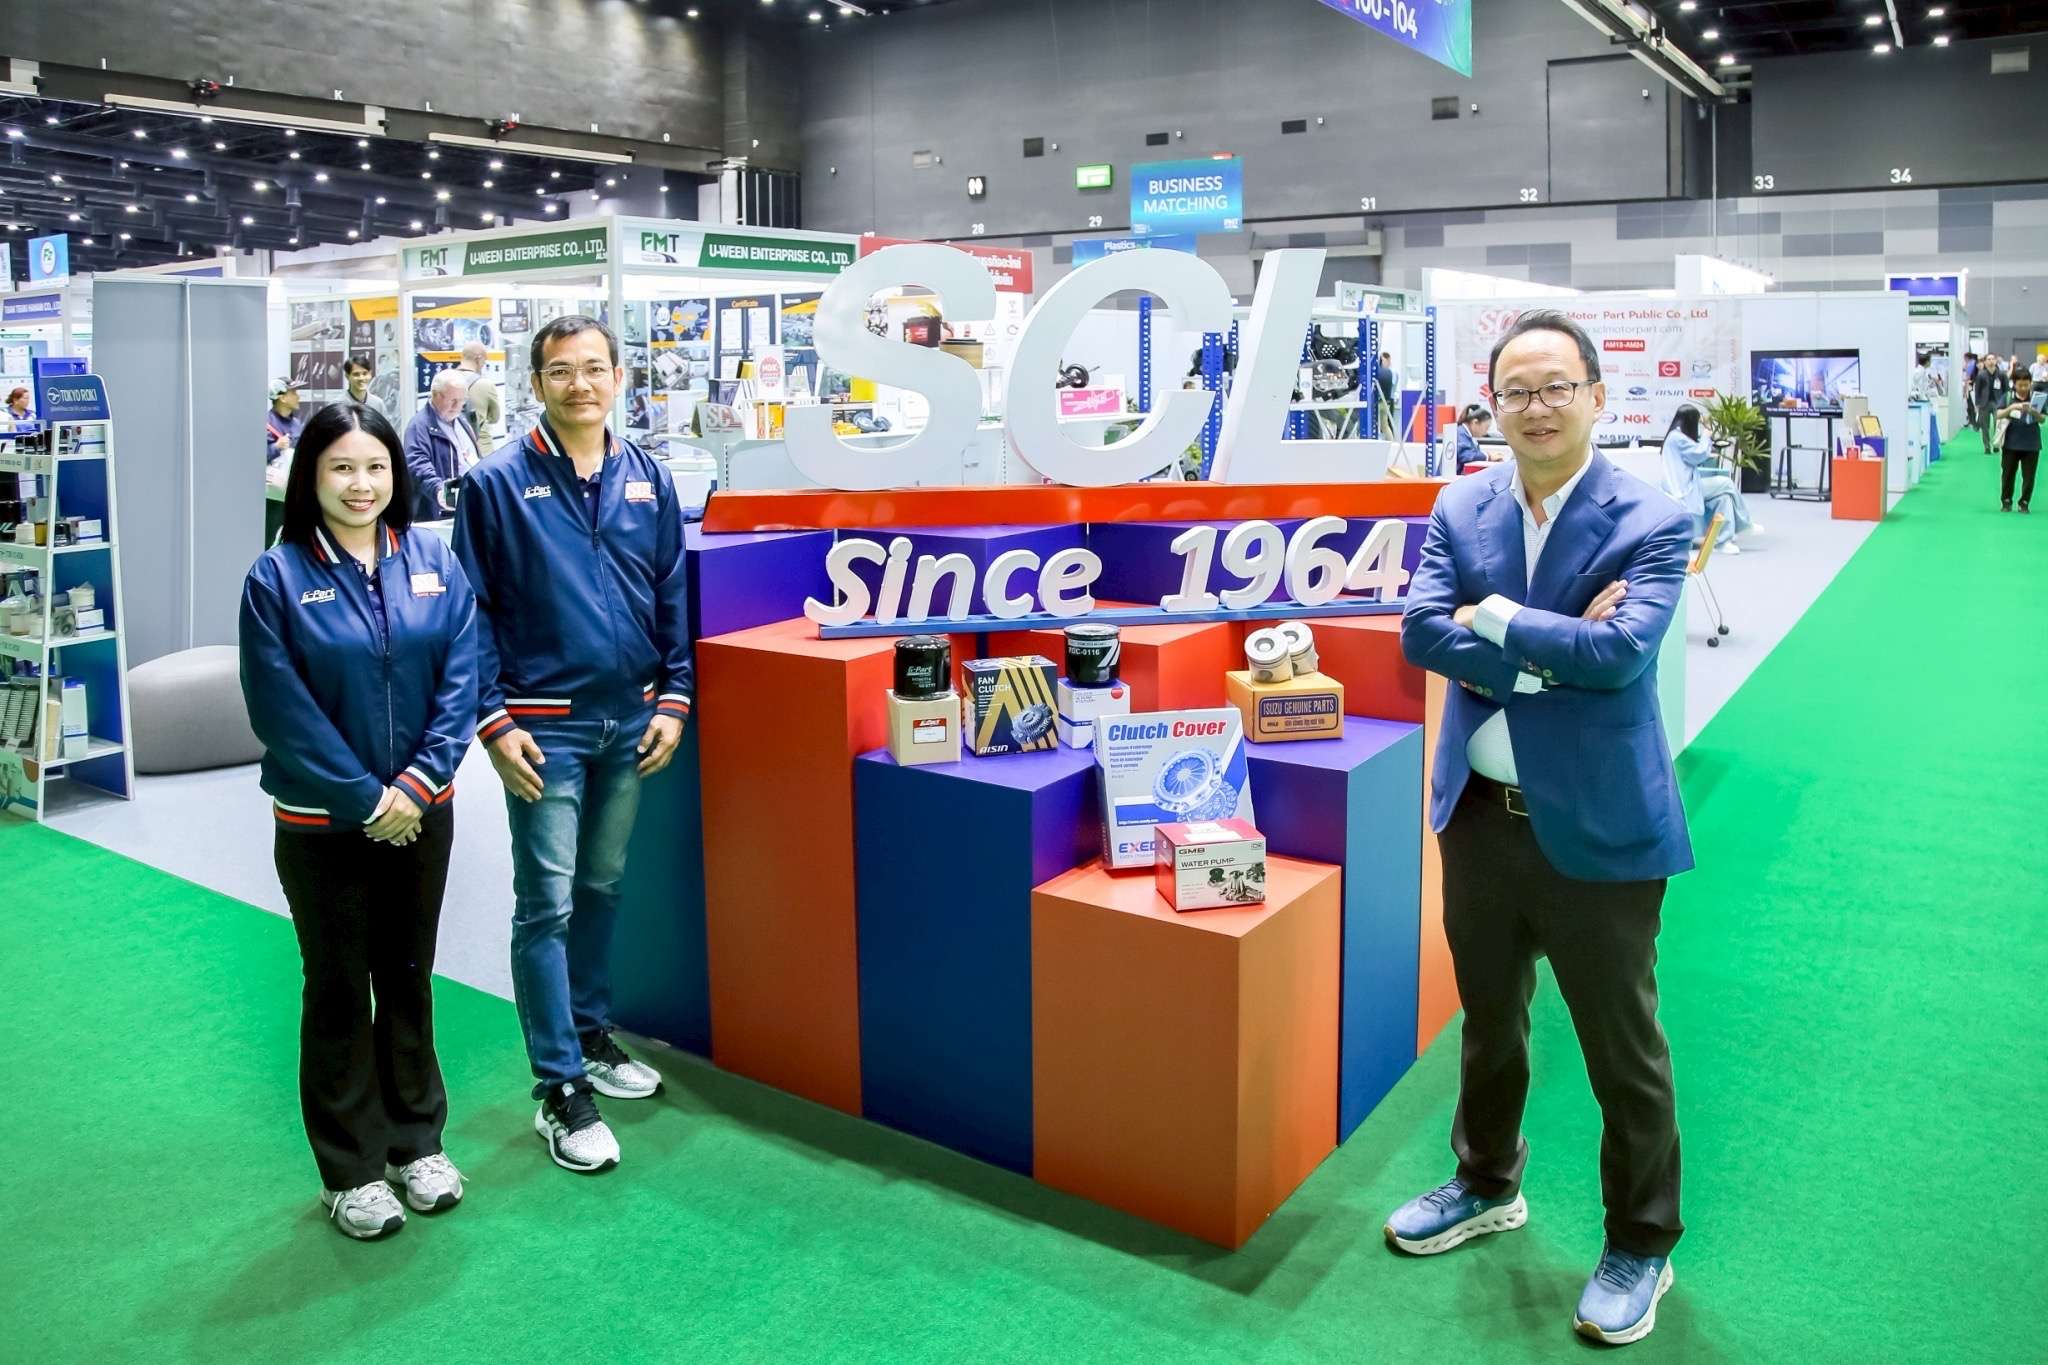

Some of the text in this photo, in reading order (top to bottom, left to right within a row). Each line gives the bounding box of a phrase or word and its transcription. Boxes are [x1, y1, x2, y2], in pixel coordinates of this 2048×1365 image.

[226, 75, 234, 87] J
[334, 89, 344, 101] K
[425, 101, 433, 113] L
[1754, 175, 1774, 189] 33
[1890, 168, 1912, 183] 34
[1149, 175, 1223, 194] BUSINESS
[1520, 188, 1538, 202] 32
[1143, 195, 1228, 213] MATCHING
[1361, 197, 1376, 210] 31
[1089, 216, 1103, 228] 29
[971, 224, 985, 235] 28
[641, 232, 680, 252] FMT
[1104, 241, 1136, 250] Plastics
[421, 247, 449, 267] FMT
[470, 250, 503, 265] U-WEEN
[504, 243, 562, 262] ENTERPRISE
[709, 244, 748, 259] U-WEEN
[750, 246, 809, 263] ENTERPRISE
[1603, 311, 1626, 320] Part
[1629, 309, 1662, 320] Public
[783, 243, 1392, 491] SCL
[1623, 413, 1652, 425] NGK
[804, 516, 1409, 626] Since 1964
[978, 676, 995, 685] FAN
[978, 683, 1011, 694] CLUTCH
[1263, 699, 1334, 715] ISUZU GENUINE PARTS
[1108, 719, 1227, 742] Clutch Cover
[1178, 847, 1206, 855] GMB
[1181, 857, 1235, 868] WATER PUMP
